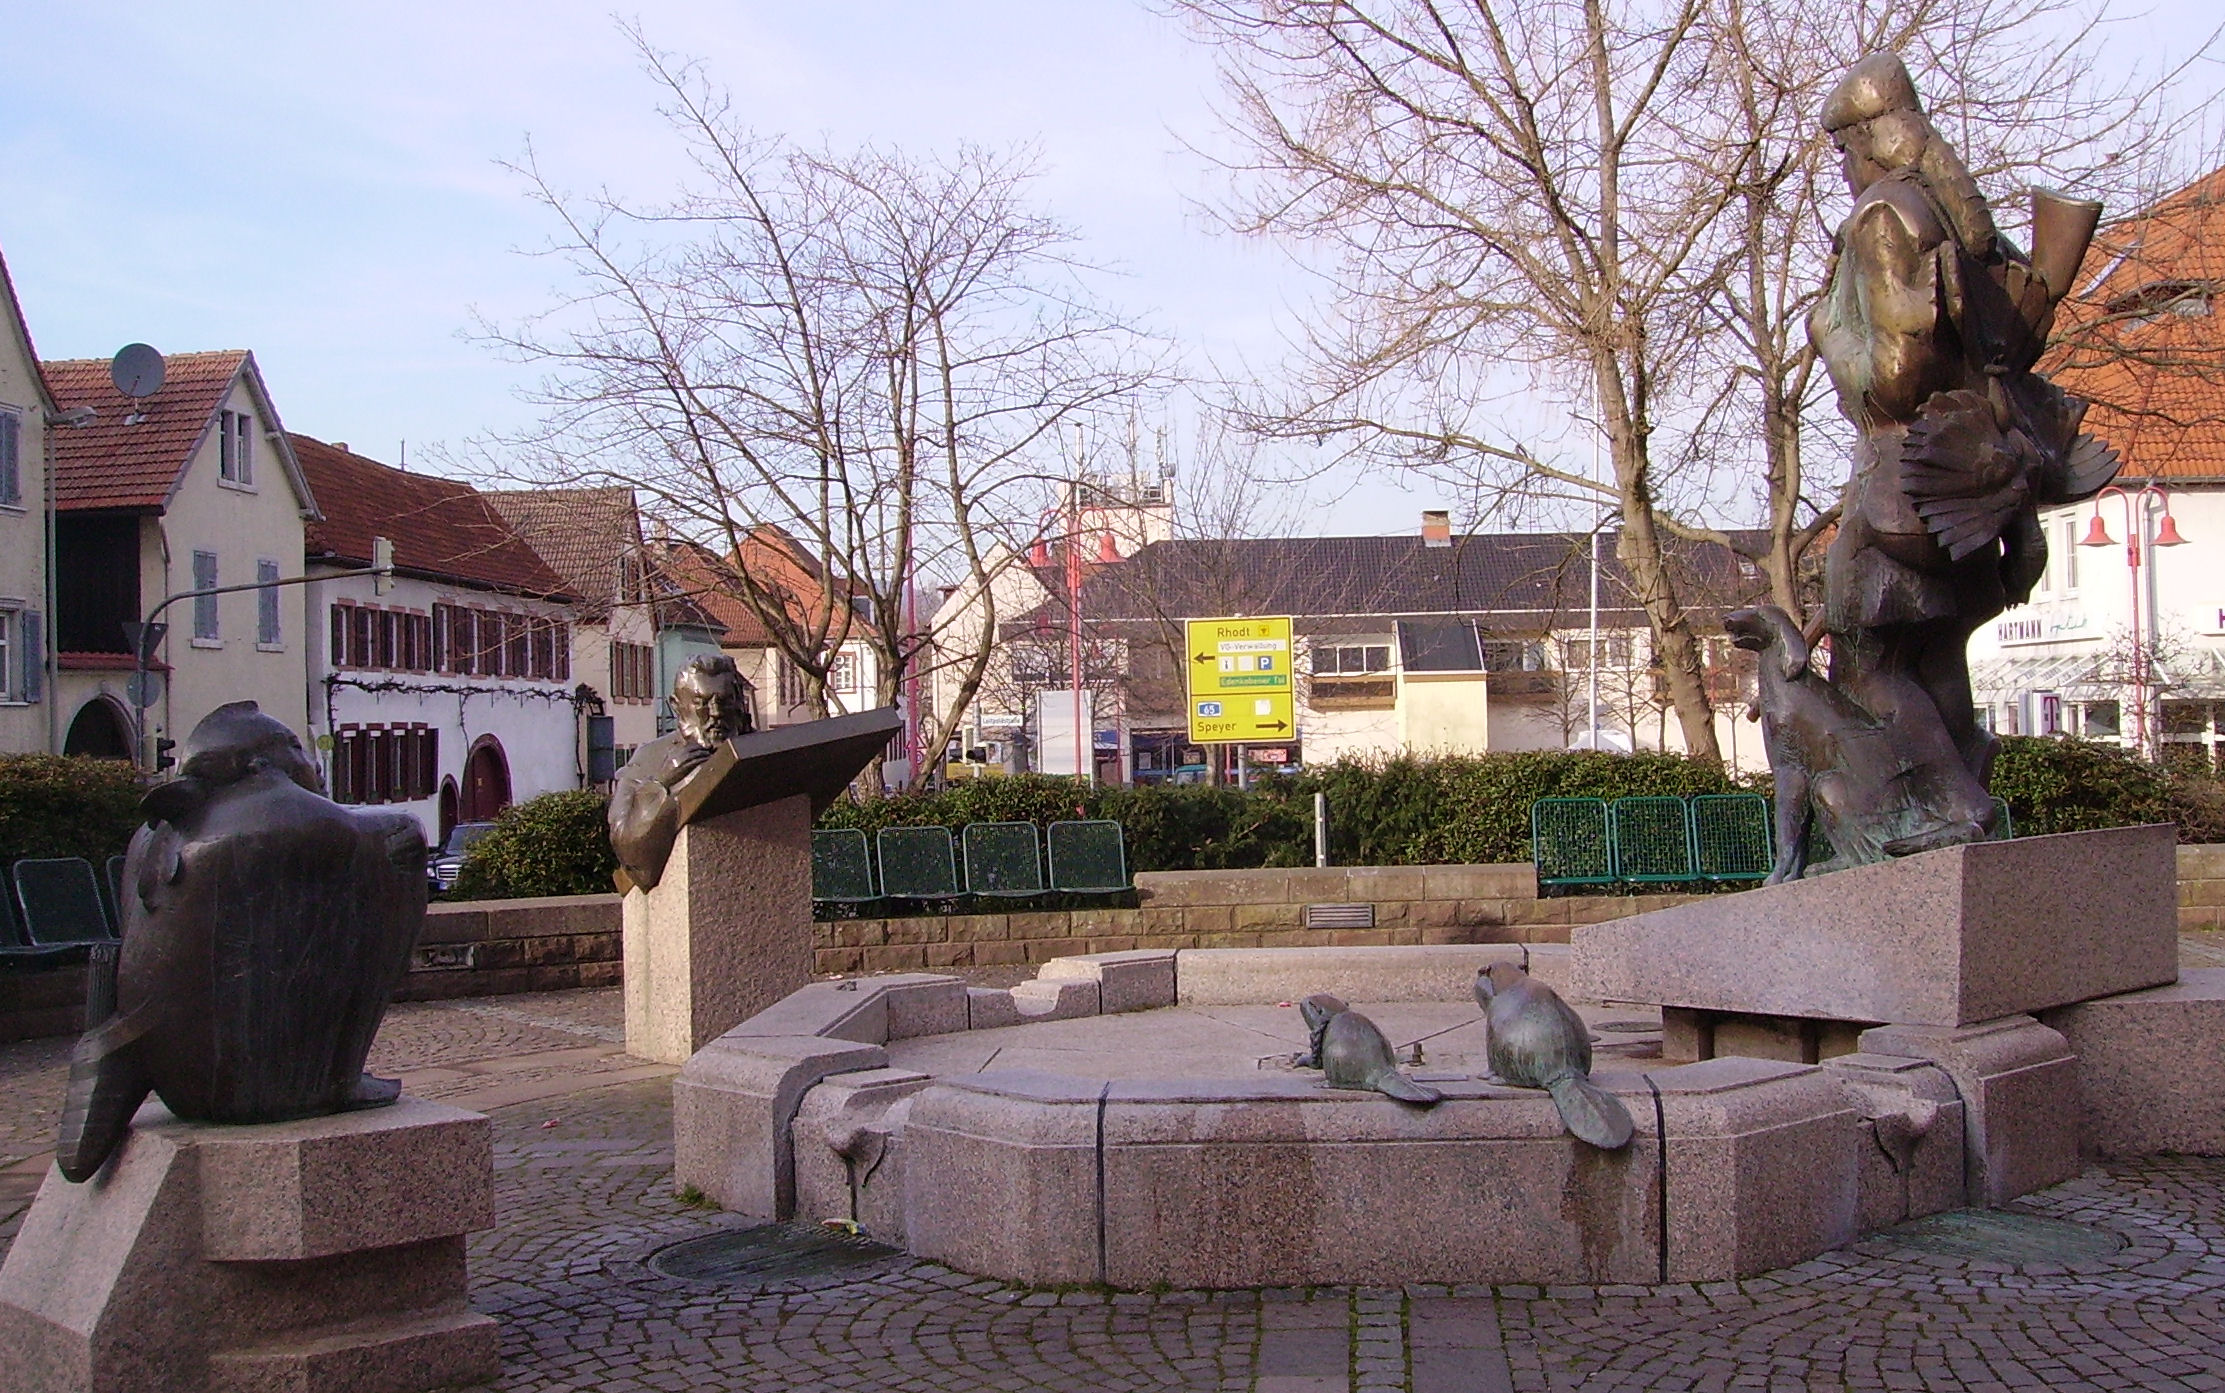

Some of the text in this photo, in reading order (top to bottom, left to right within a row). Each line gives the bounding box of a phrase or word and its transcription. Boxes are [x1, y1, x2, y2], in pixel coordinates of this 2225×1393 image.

[1217, 626, 1250, 638] Rhodt
[1998, 619, 2042, 641] HARTMANN
[1260, 657, 1270, 669] P
[1203, 705, 1215, 715] 65
[2043, 696, 2060, 733] T
[1197, 721, 1237, 733] Speyer
